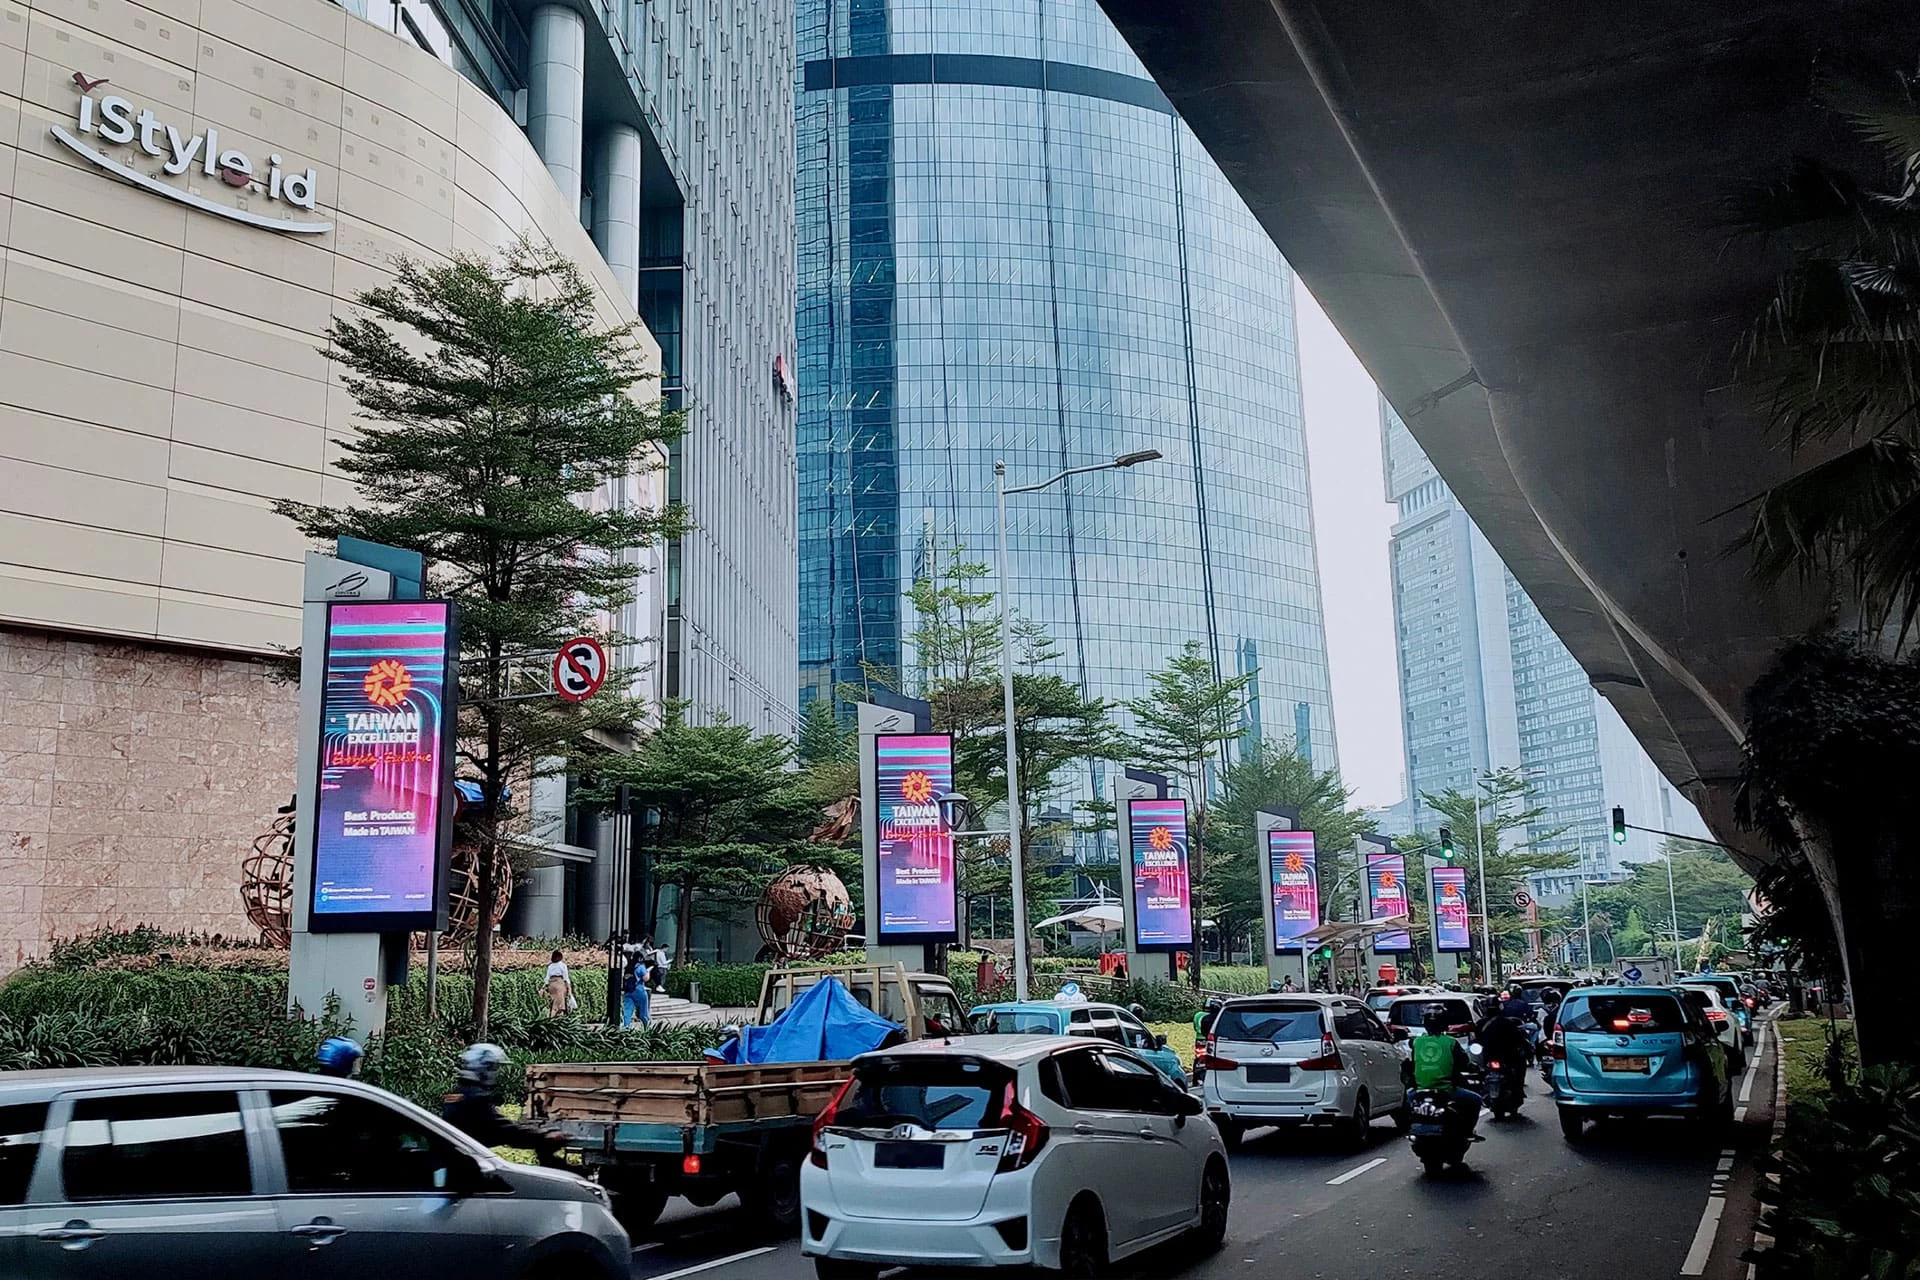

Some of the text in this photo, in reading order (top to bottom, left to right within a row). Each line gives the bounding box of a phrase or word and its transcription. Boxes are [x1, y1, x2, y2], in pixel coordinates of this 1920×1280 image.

[74, 74, 317, 210] iStyle.id
[345, 711, 419, 731] TAIWAN
[347, 732, 419, 744] EXCELLENCE
[344, 809, 416, 821] Best Products
[892, 805, 939, 818] TAIWAN
[344, 826, 369, 836] Made
[379, 826, 416, 836] TAIWAN
[1143, 851, 1178, 861] TAIWAN
